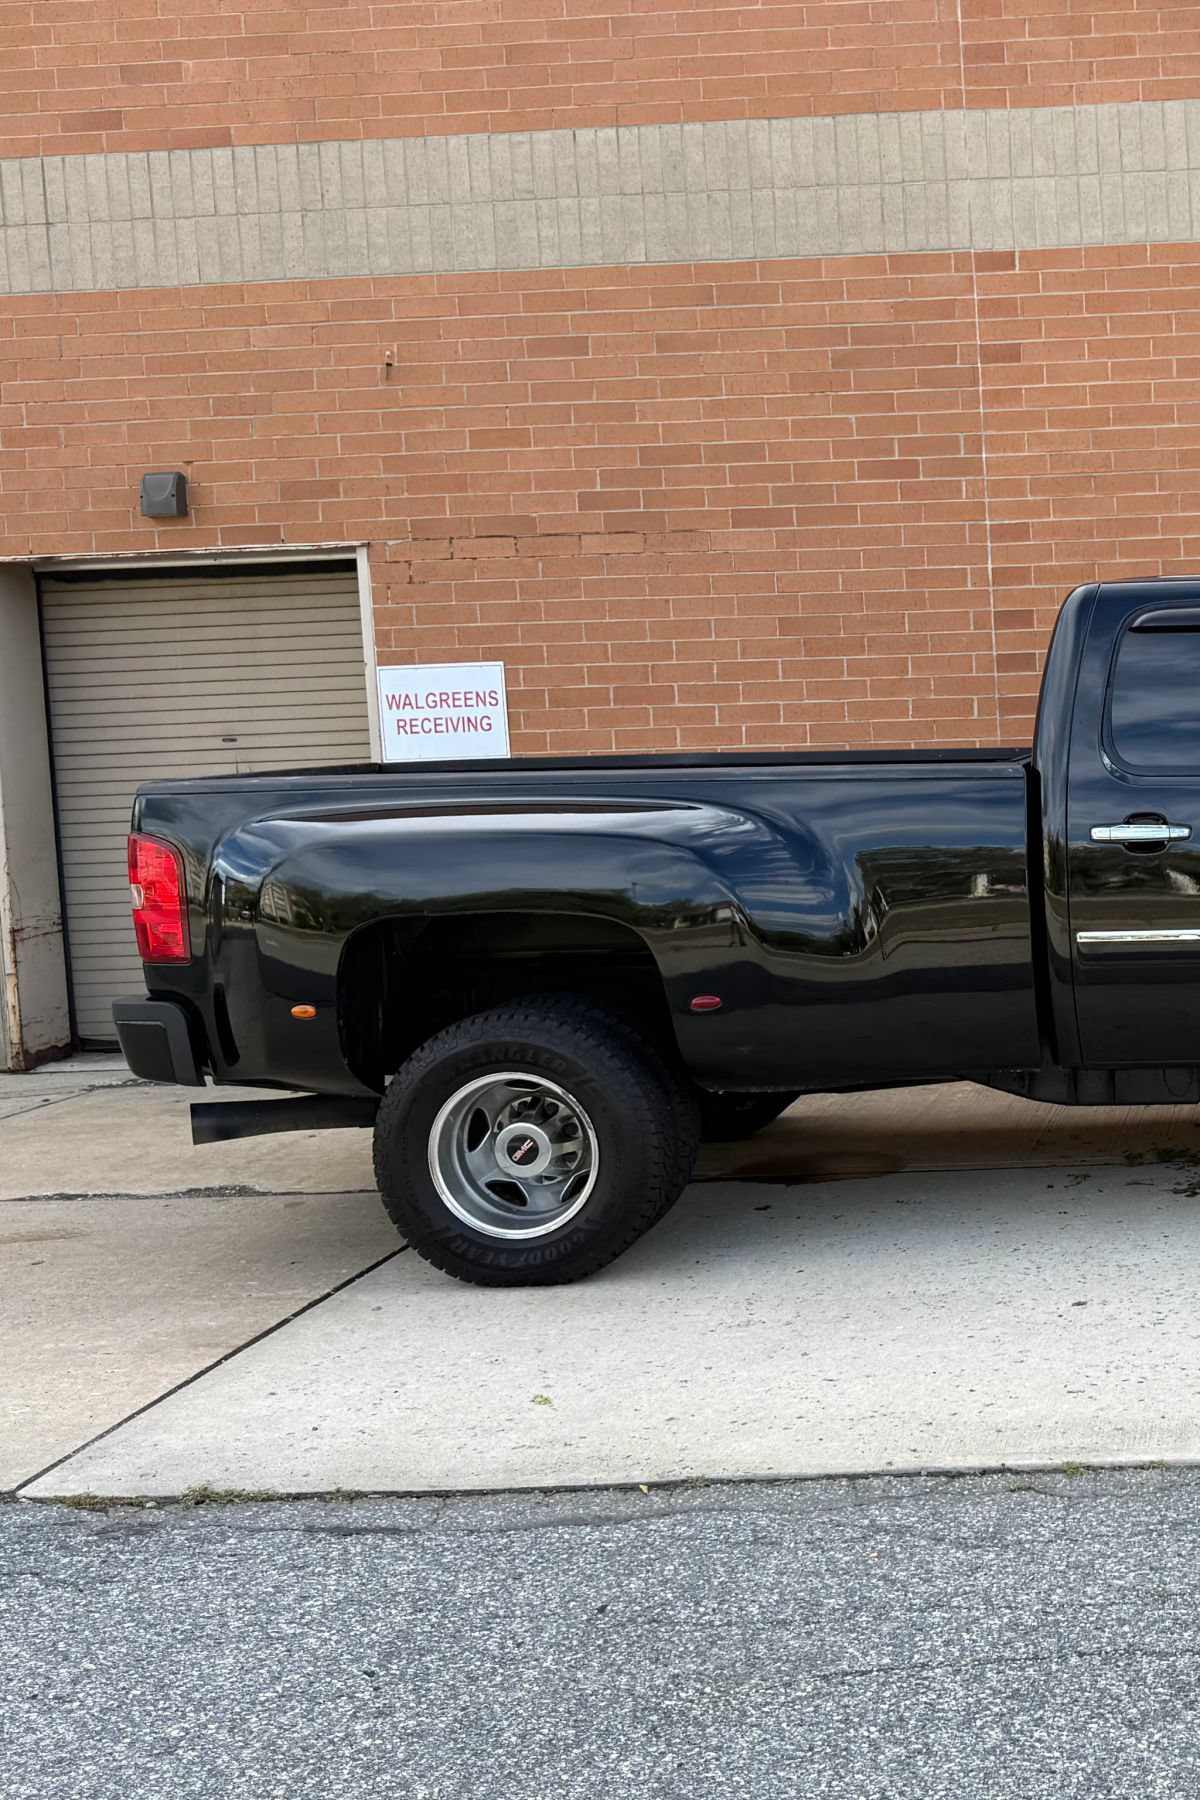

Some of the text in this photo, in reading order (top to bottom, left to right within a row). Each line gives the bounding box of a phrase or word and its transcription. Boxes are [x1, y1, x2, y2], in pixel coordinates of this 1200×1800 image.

[385, 690, 499, 711] WALGREENS
[396, 715, 493, 735] RECEIVING
[512, 1139, 534, 1162] GMC
